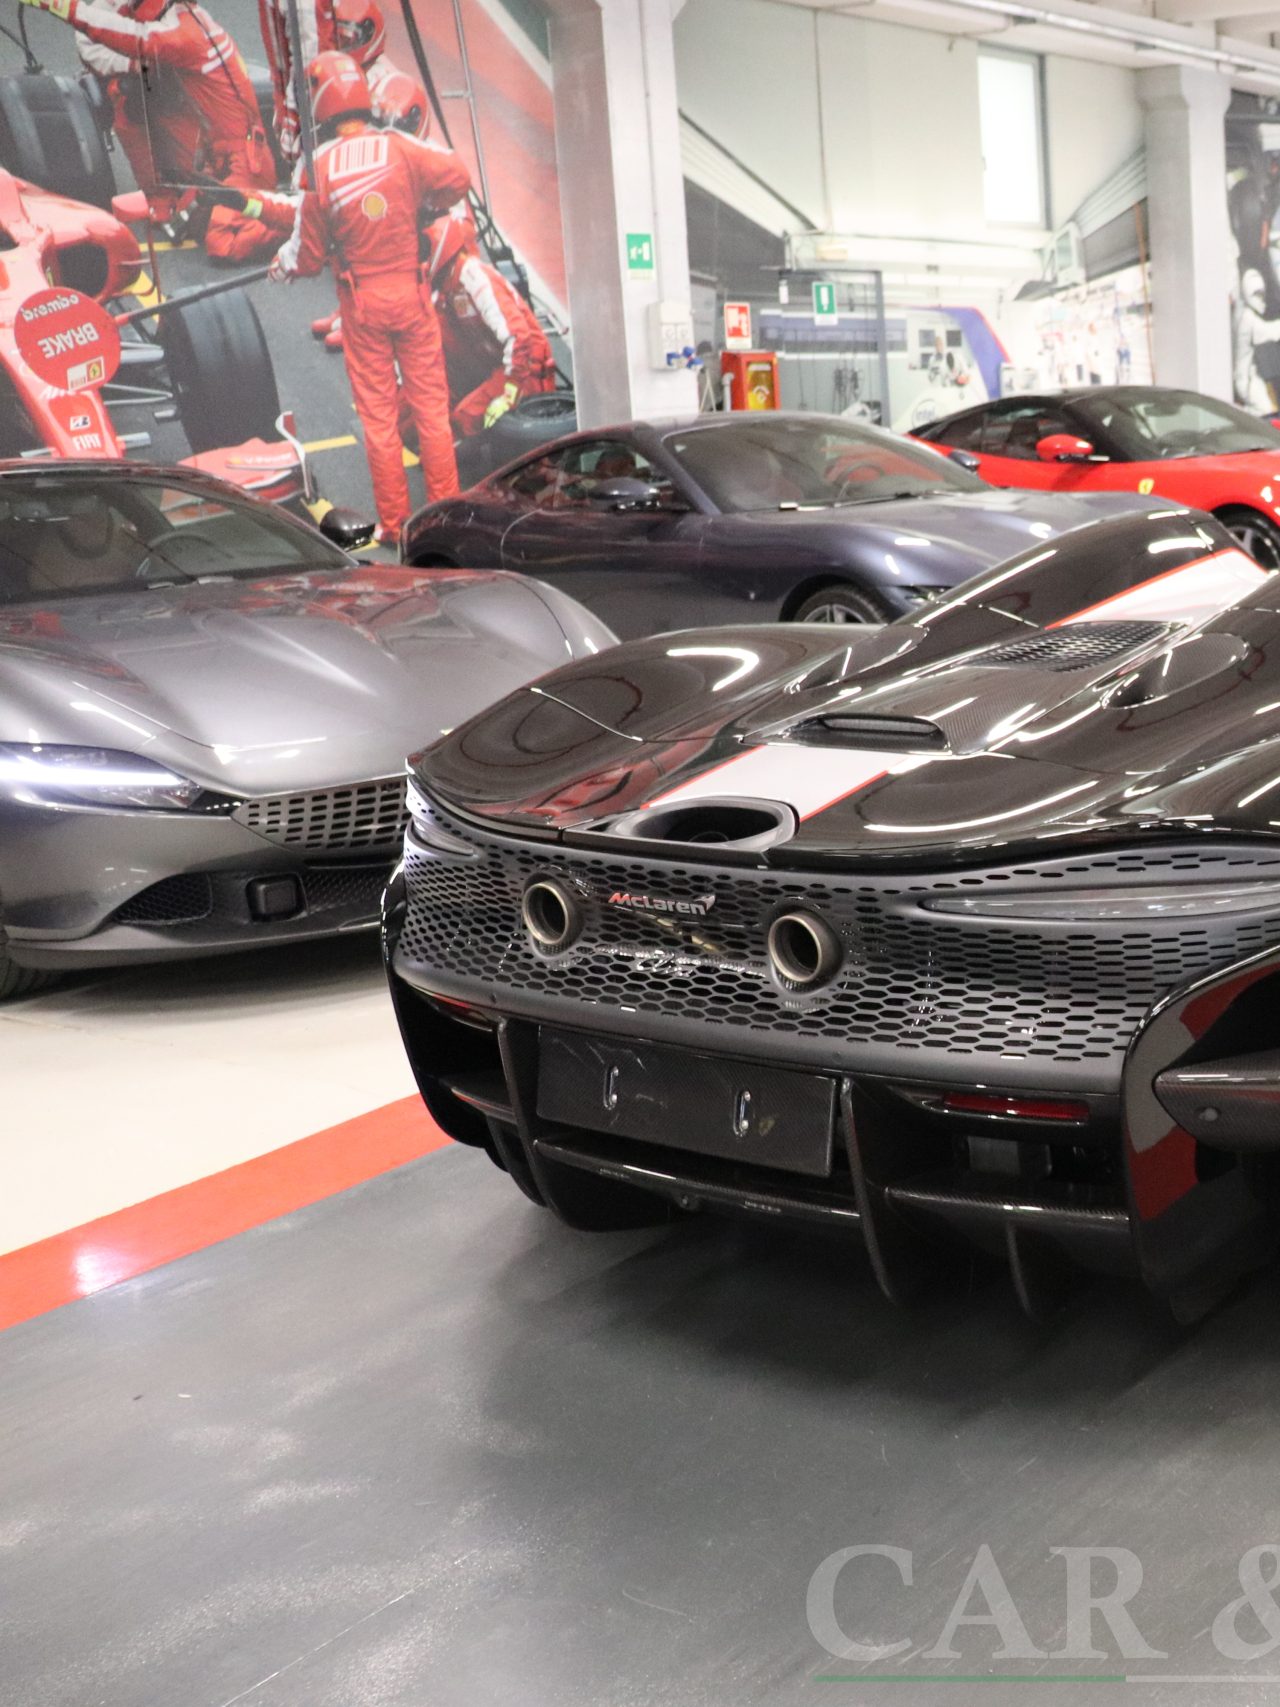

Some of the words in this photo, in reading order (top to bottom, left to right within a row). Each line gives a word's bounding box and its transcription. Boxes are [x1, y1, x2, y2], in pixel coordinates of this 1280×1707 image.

[20, 293, 80, 322] brembo
[37, 321, 100, 360] BRAKE
[71, 432, 102, 451] FIAT
[607, 892, 706, 916] McLaren
